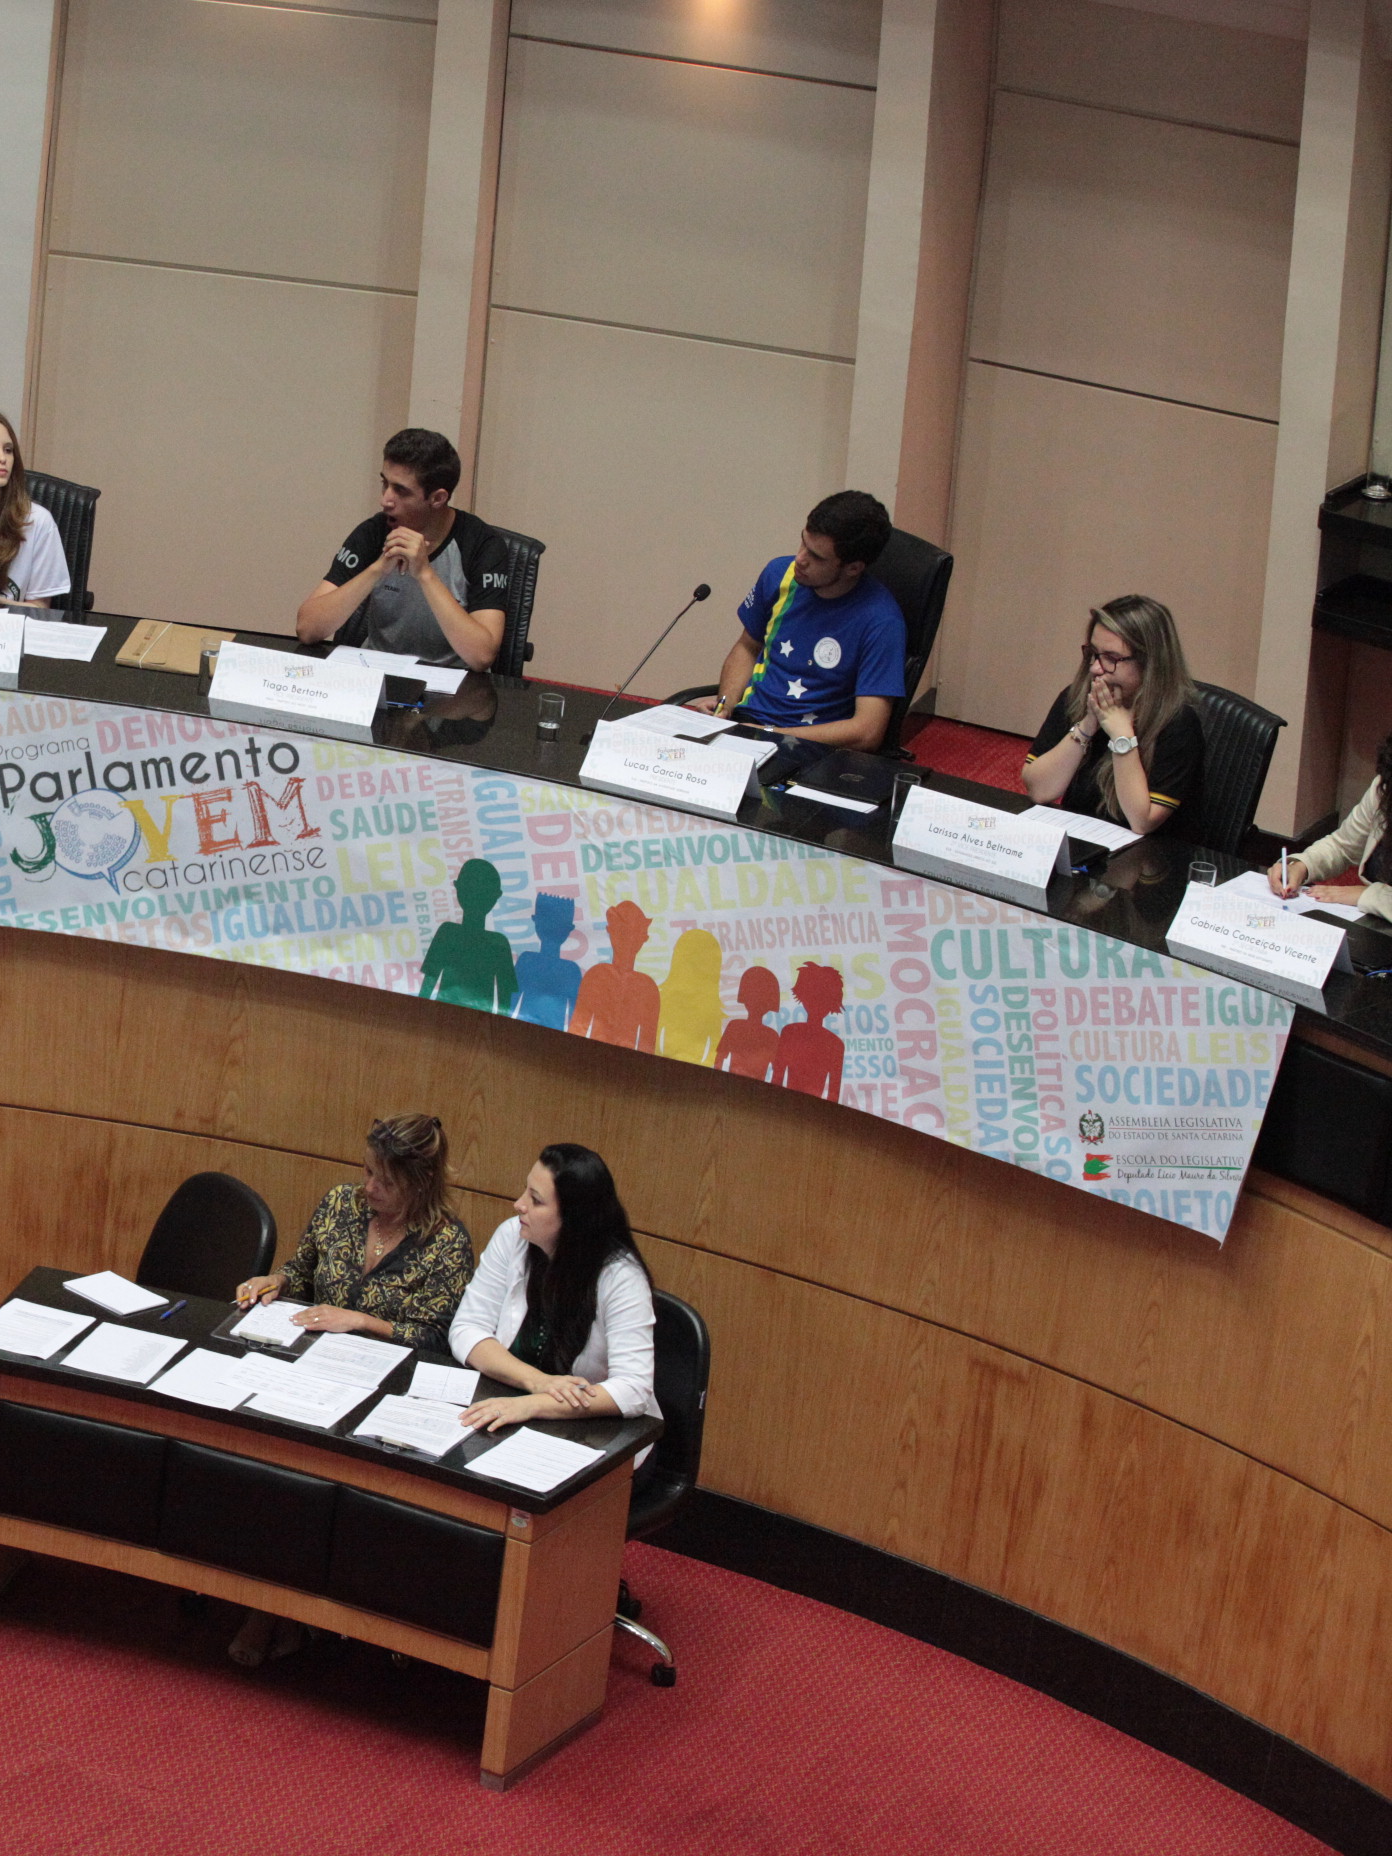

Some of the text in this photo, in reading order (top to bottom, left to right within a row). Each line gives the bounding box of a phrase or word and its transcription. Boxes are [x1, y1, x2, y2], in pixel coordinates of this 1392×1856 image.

[262, 679, 328, 699] Tiago Bertotto
[96, 711, 276, 755] DEMOC
[316, 765, 435, 801] DEBATE
[624, 758, 649, 771] Lucas
[686, 772, 707, 785] Rosa
[329, 795, 439, 841] SAÚDE
[928, 823, 959, 839] Larissa
[960, 833, 984, 847] Alves
[986, 840, 1023, 859] Beltrame
[123, 847, 327, 893] catarinense
[336, 837, 449, 894] LEIS
[211, 891, 409, 944] IGUALDADE
[930, 927, 1165, 981] CULTURA
[1190, 916, 1230, 936] Gabriela
[1232, 929, 1281, 952] Conceição
[1284, 944, 1318, 964] Vicente
[880, 868, 945, 1142] EMOCRAC
[1064, 986, 1201, 1027] DEBATE
[844, 1038, 894, 1053] MENTO
[1030, 988, 1068, 1134] POLÍTICA
[1069, 1030, 1271, 1065] CULTURA LEIS
[843, 1055, 897, 1079] ESSO
[934, 986, 971, 1148] IGUALDAD
[1001, 986, 1042, 1174] DESENVOL
[1075, 1064, 1271, 1109] SOCIEDADE
[842, 1082, 899, 1119] ATE
[1109, 1116, 1243, 1128] ASSEMBLEIA LEGISLATIVA
[1109, 1131, 1244, 1141] DO ESTADO DE SANTA CATARINA
[1116, 1154, 1245, 1166] ESCOLA DO LEGISLATIVO
[1117, 1168, 1155, 1183] Deputado
[1178, 1170, 1205, 1181] Mauro
[1207, 1170, 1217, 1181] da
